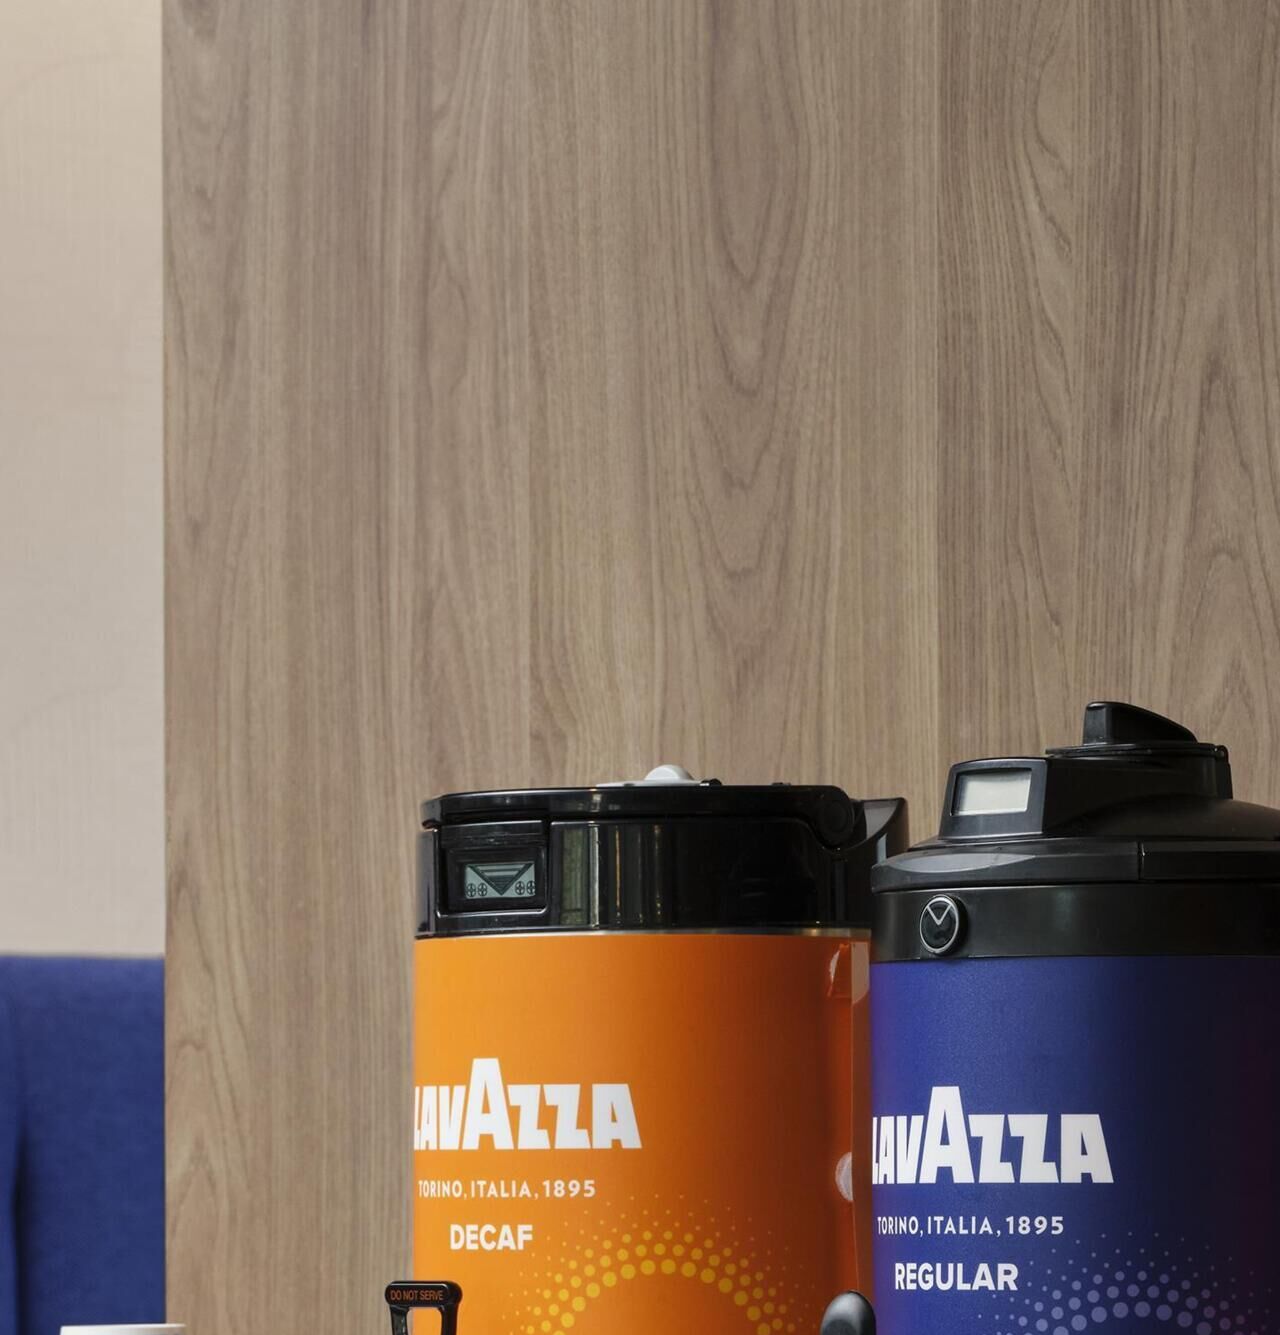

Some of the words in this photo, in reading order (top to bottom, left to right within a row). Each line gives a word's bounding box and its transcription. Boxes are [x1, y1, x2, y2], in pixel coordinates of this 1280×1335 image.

[414, 1057, 643, 1151] LAVAZZA
[872, 1085, 1114, 1185] LAVAZZA
[542, 1179, 596, 1199] 1895
[449, 1223, 533, 1251] DECAF
[1005, 1215, 1064, 1236] 1895
[894, 1262, 1019, 1291] REGULAR
